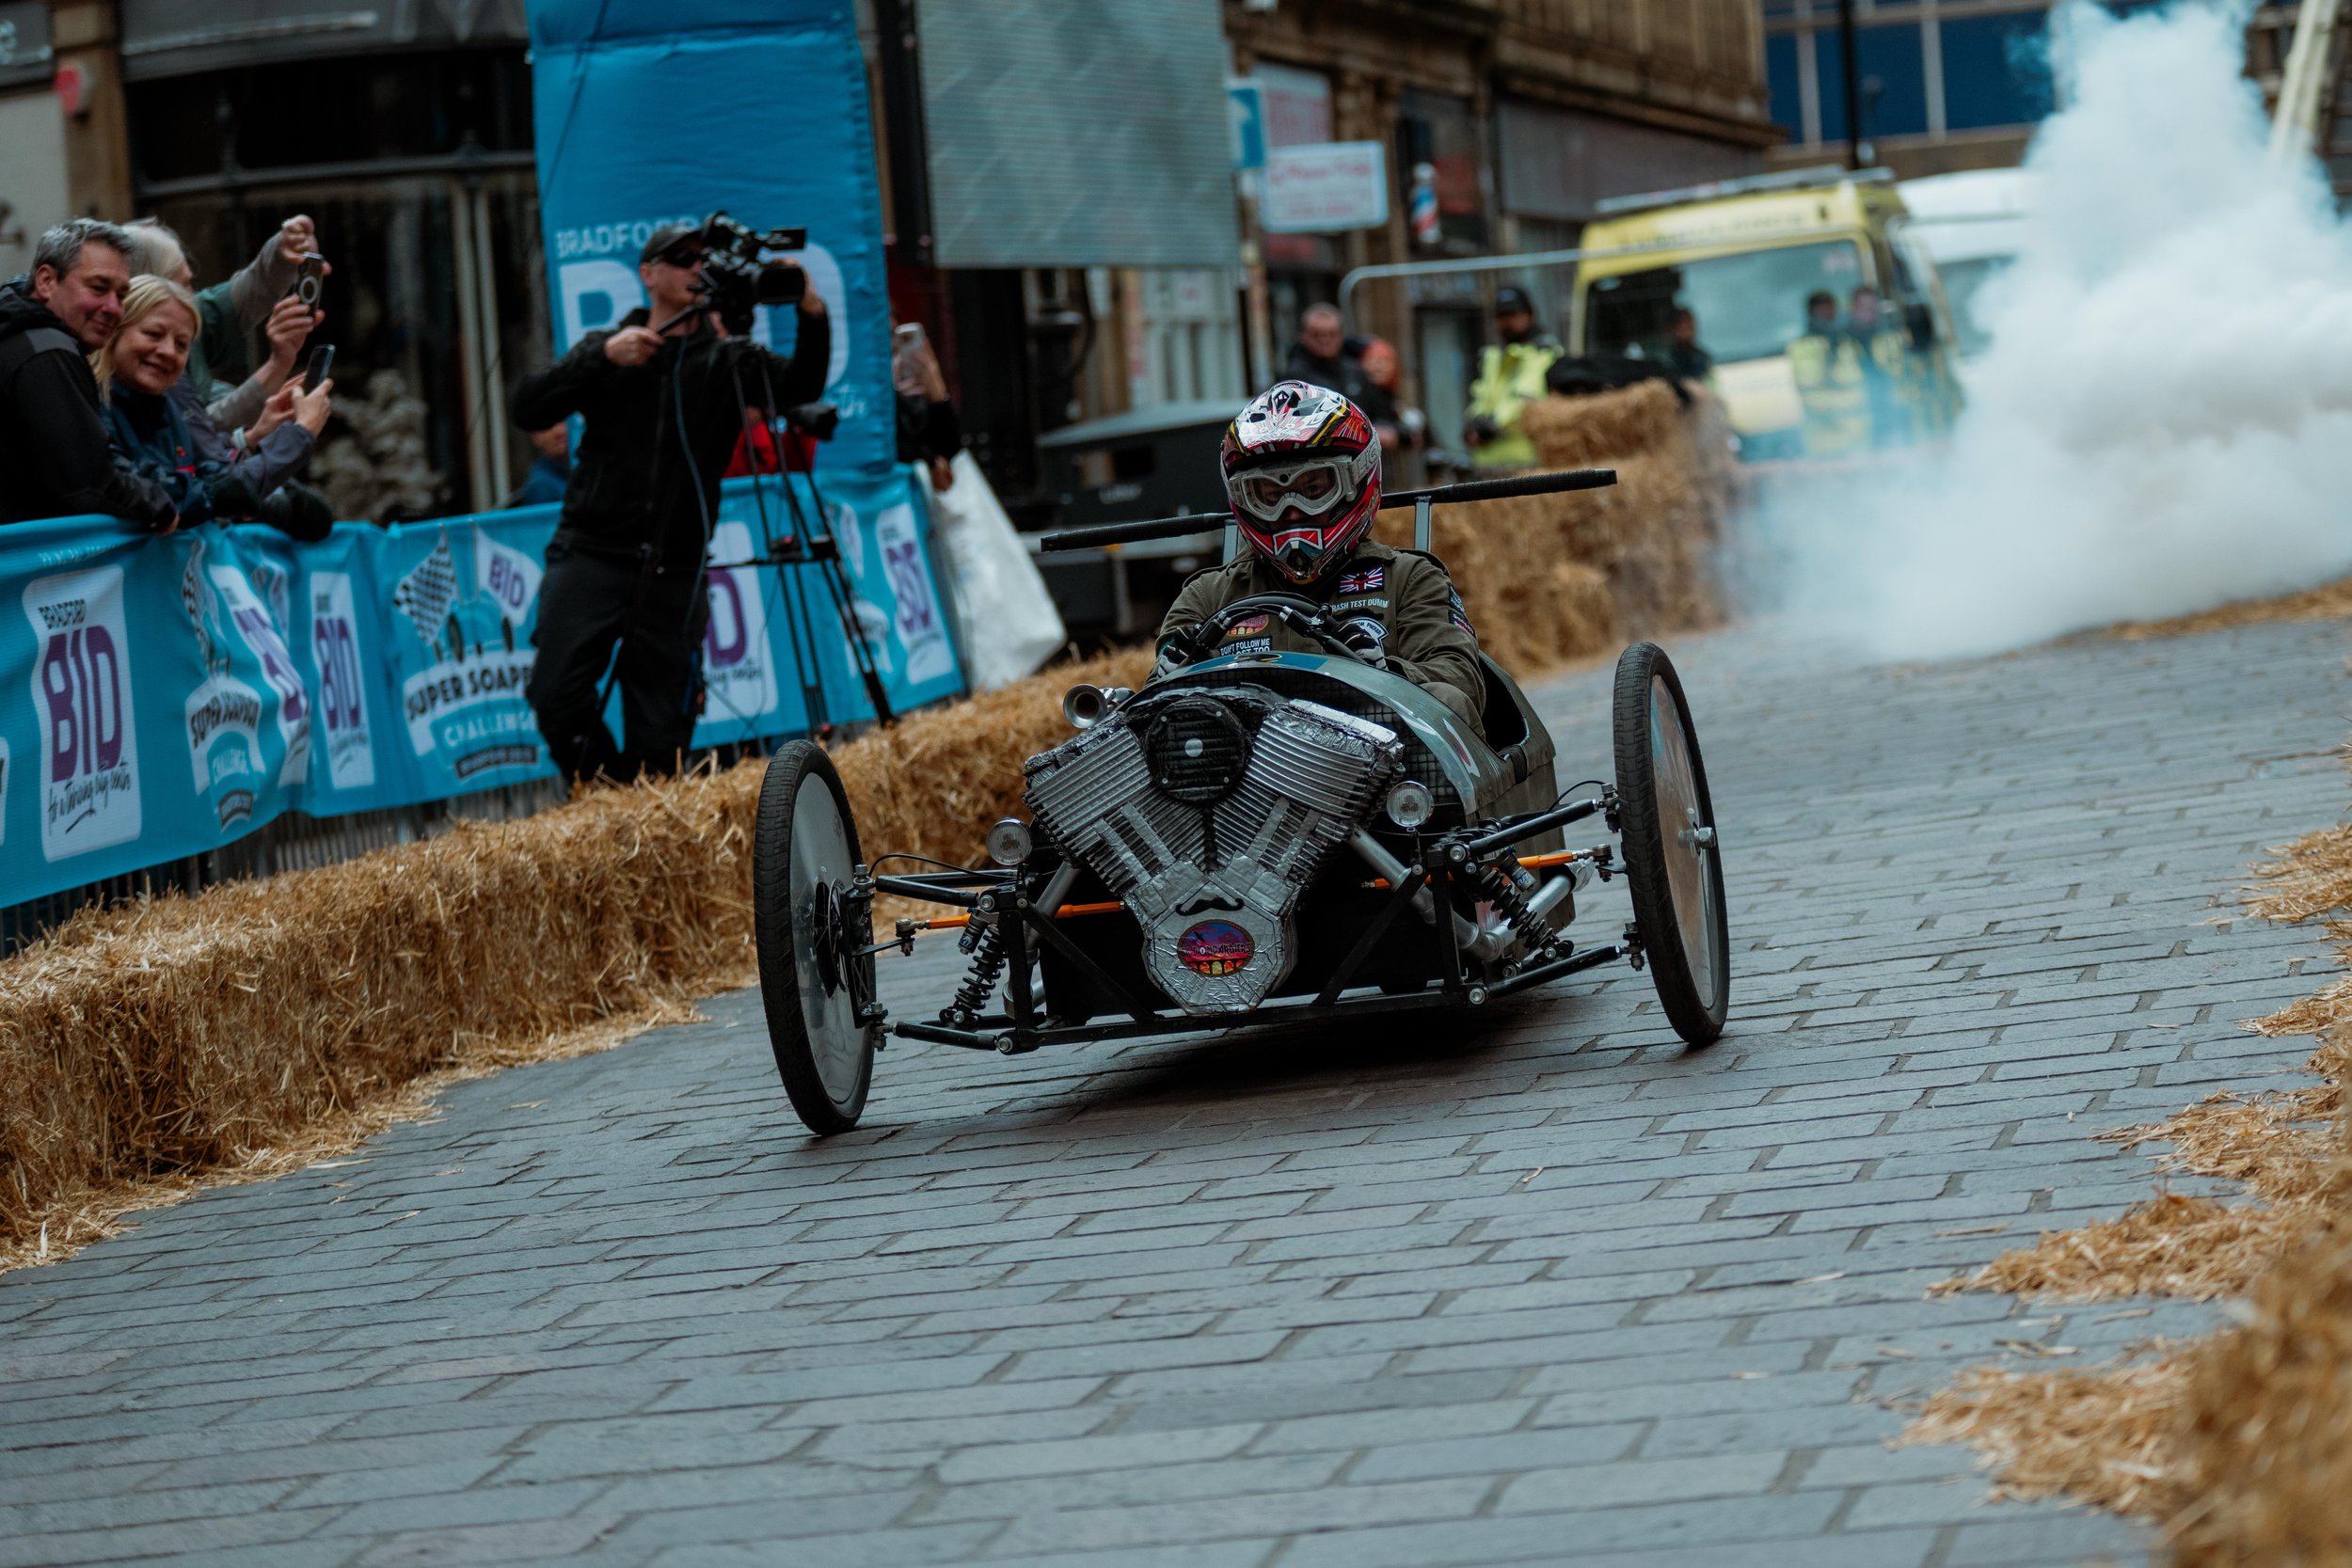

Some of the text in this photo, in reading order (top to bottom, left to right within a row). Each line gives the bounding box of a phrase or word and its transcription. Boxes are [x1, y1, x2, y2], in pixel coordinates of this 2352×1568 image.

[1235, 640, 1261, 650] FOLLOW
[1261, 638, 1270, 646] ME
[42, 625, 123, 784] BID
[409, 675, 465, 721] SUPER
